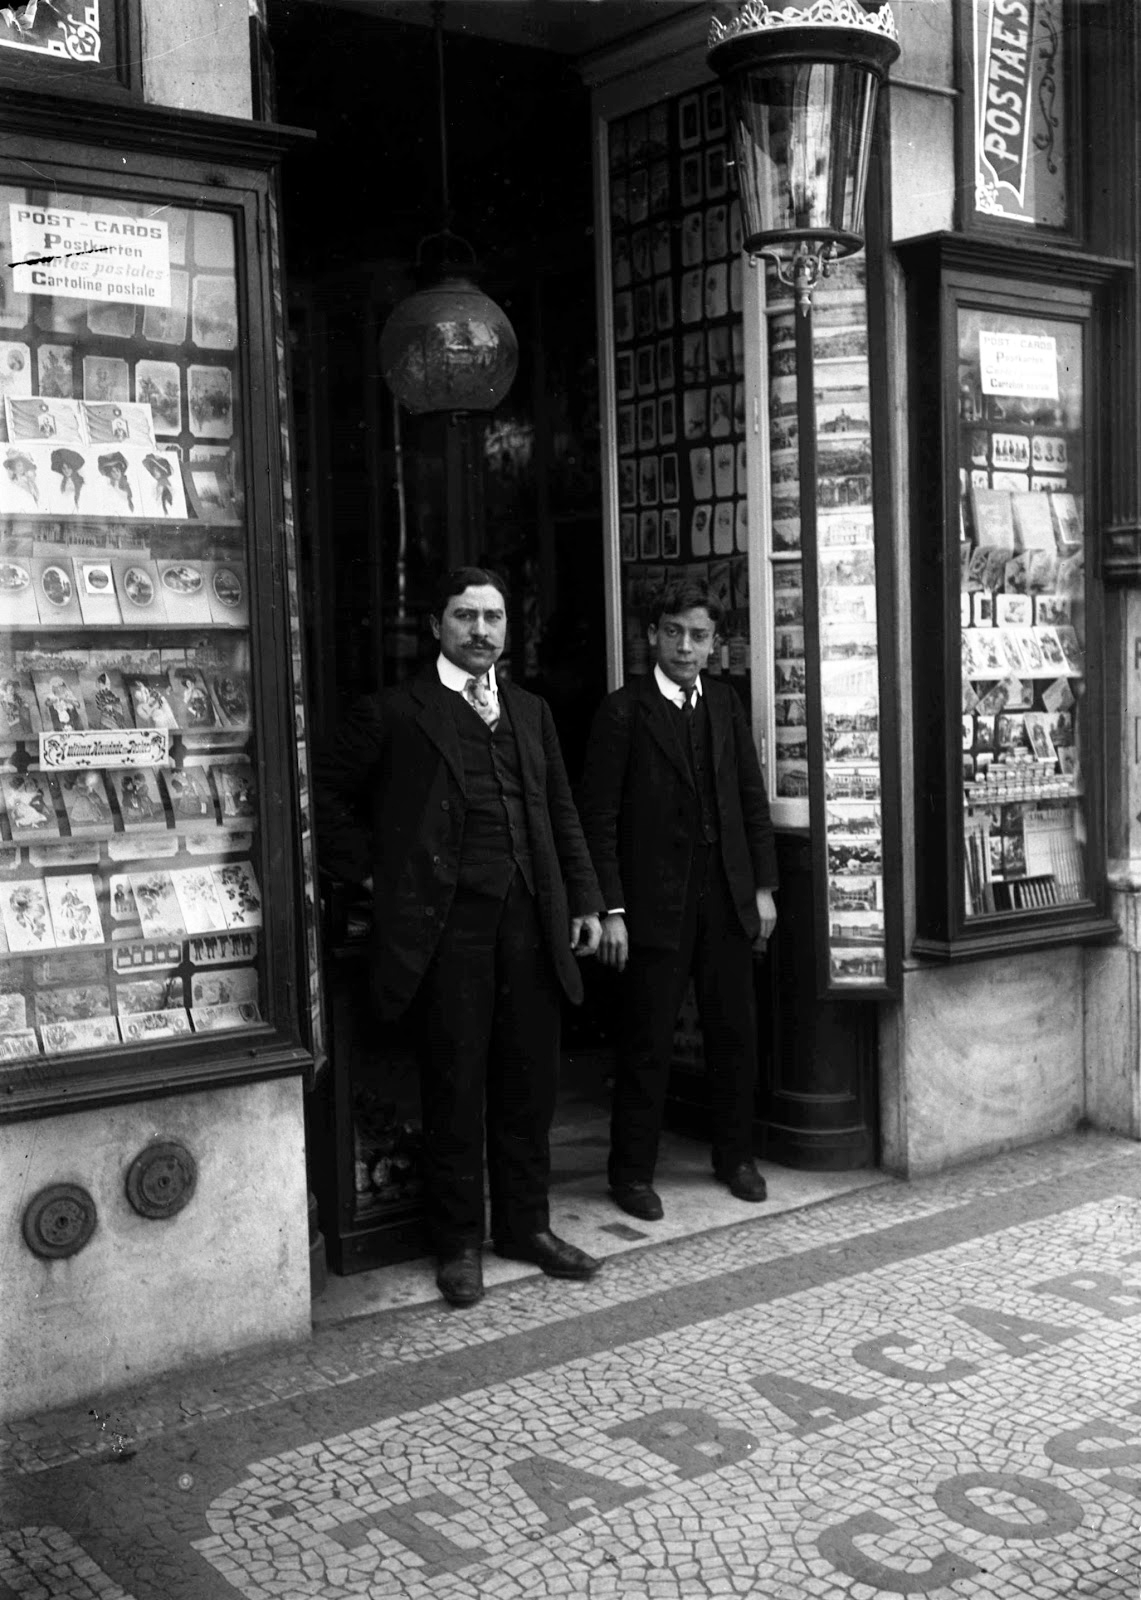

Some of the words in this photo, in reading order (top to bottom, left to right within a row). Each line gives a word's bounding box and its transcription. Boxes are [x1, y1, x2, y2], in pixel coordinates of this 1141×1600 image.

[984, 0, 1029, 164] POSTAES
[17, 210, 75, 228] POST
[95, 220, 162, 239] CARDS
[44, 232, 143, 258] Postkarten
[31, 271, 102, 292] Cartoline
[107, 281, 156, 297] postale
[327, 1250, 1141, 1577] TABACAR
[816, 1402, 1141, 1594] COS
